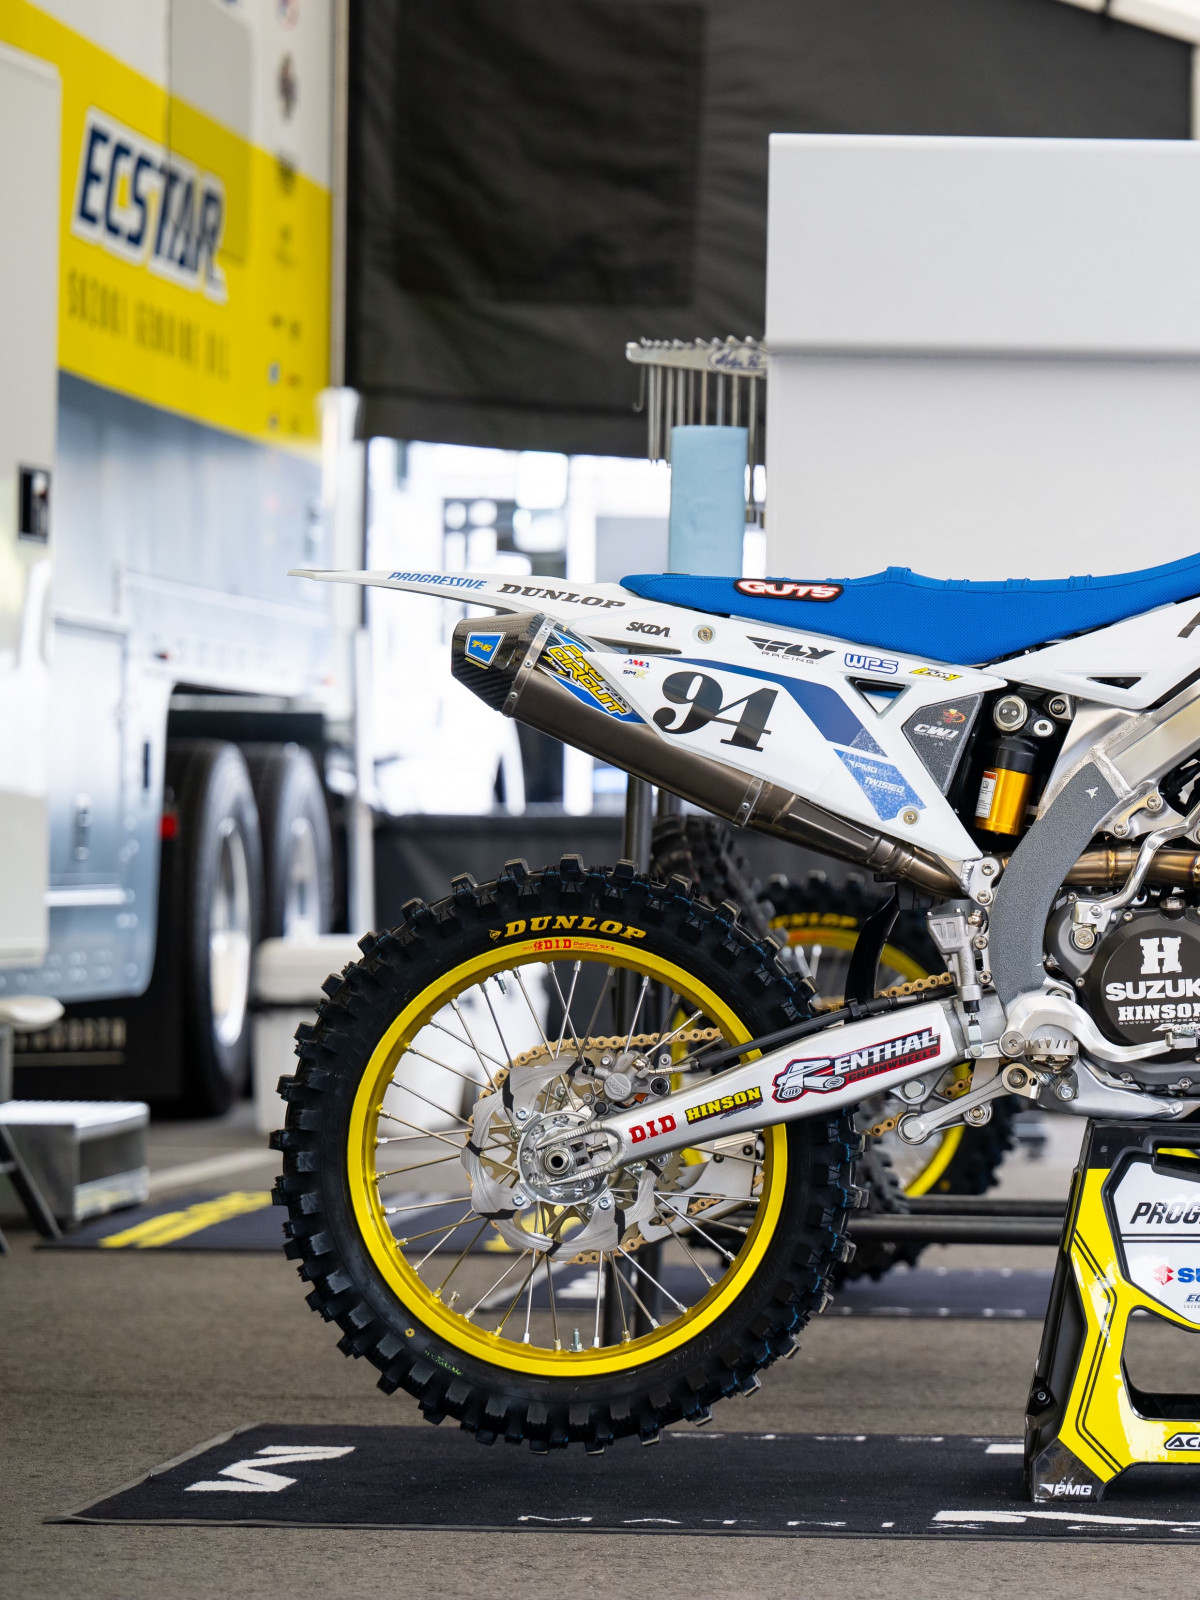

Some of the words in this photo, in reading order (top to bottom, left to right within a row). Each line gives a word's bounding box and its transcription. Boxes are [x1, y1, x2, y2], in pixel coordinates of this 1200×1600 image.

[79, 126, 224, 284] ECSTAR
[387, 571, 487, 590] PROGRESSIVE
[737, 581, 841, 600] GUTS
[496, 583, 626, 609] DUNLOP
[625, 621, 671, 638] SKDA
[746, 635, 836, 660] FLY
[762, 651, 814, 665] RACING
[844, 653, 898, 675] WPS
[549, 647, 627, 713] CIRCUIT
[653, 671, 779, 752] 94
[864, 776, 905, 793] TWISTED
[504, 915, 647, 939] DUNLOP
[850, 1047, 938, 1082] CHAINWHEELS
[685, 1087, 761, 1121] HINSON
[628, 1114, 677, 1144] D.I.D
[1054, 1482, 1092, 1497] PMG
